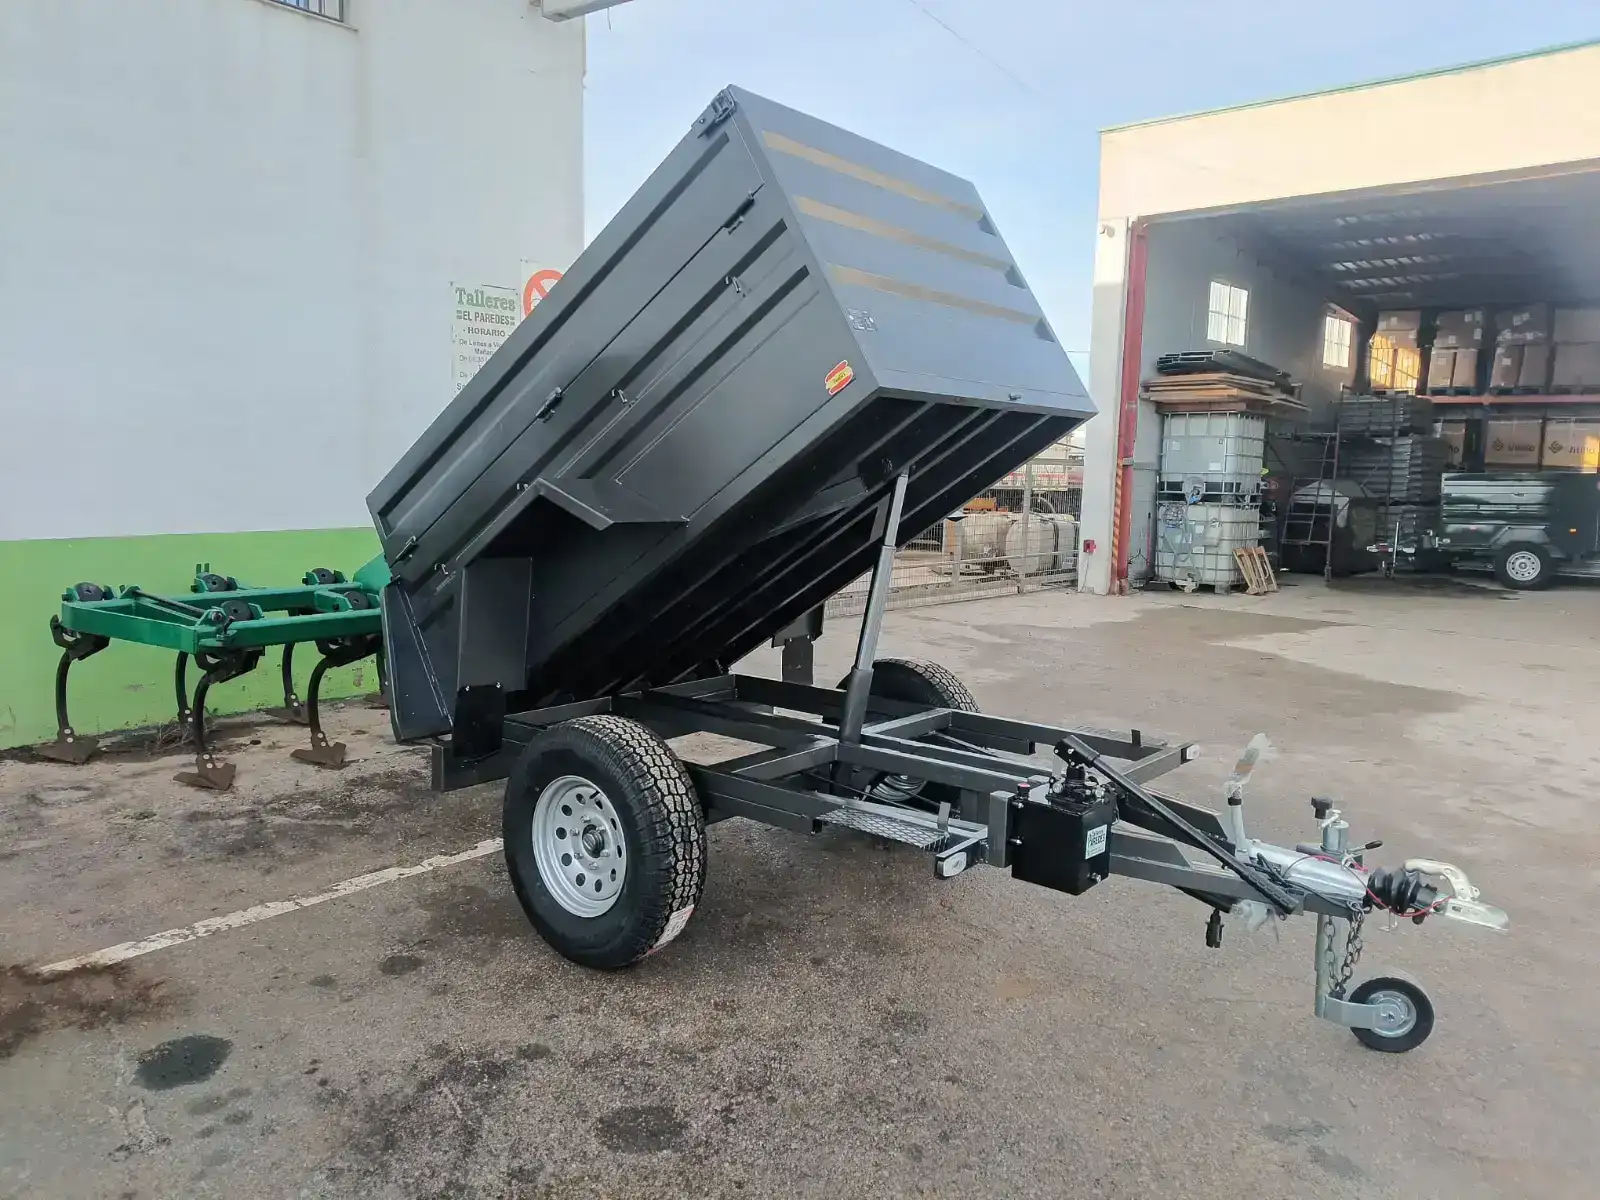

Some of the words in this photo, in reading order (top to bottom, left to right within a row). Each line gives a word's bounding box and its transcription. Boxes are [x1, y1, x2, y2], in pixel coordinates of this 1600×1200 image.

[455, 287, 516, 312] Talleres
[462, 310, 473, 322] EL
[474, 311, 510, 326] PAREDES
[467, 326, 506, 338] HORARIO
